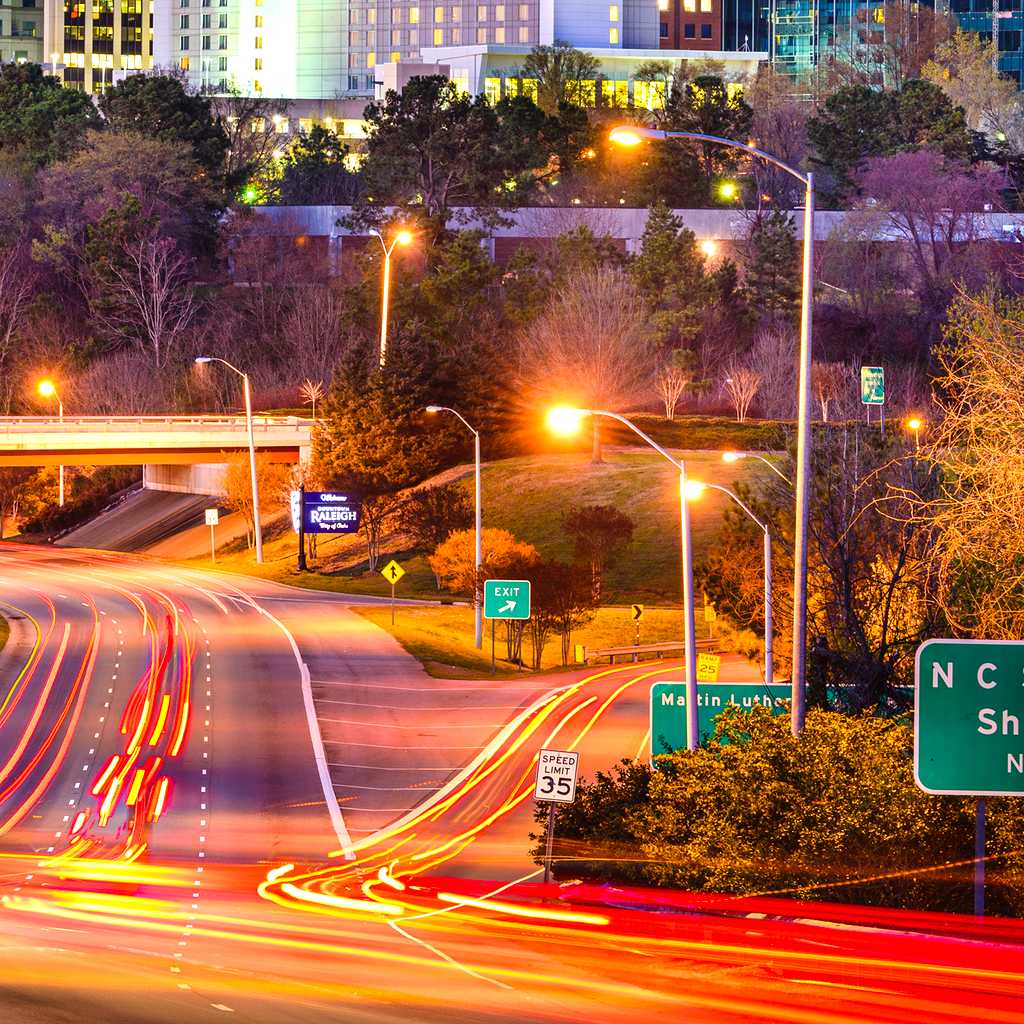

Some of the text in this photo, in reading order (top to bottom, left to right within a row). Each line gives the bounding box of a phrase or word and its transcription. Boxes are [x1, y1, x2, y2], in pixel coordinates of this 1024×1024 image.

[311, 510, 357, 523] RALEIGH
[494, 587, 520, 597] EXIT
[700, 663, 716, 674] 25
[661, 692, 721, 707] Matin
[542, 754, 576, 766] SPEED
[544, 765, 571, 775] LIMIT
[540, 775, 572, 796] 35
